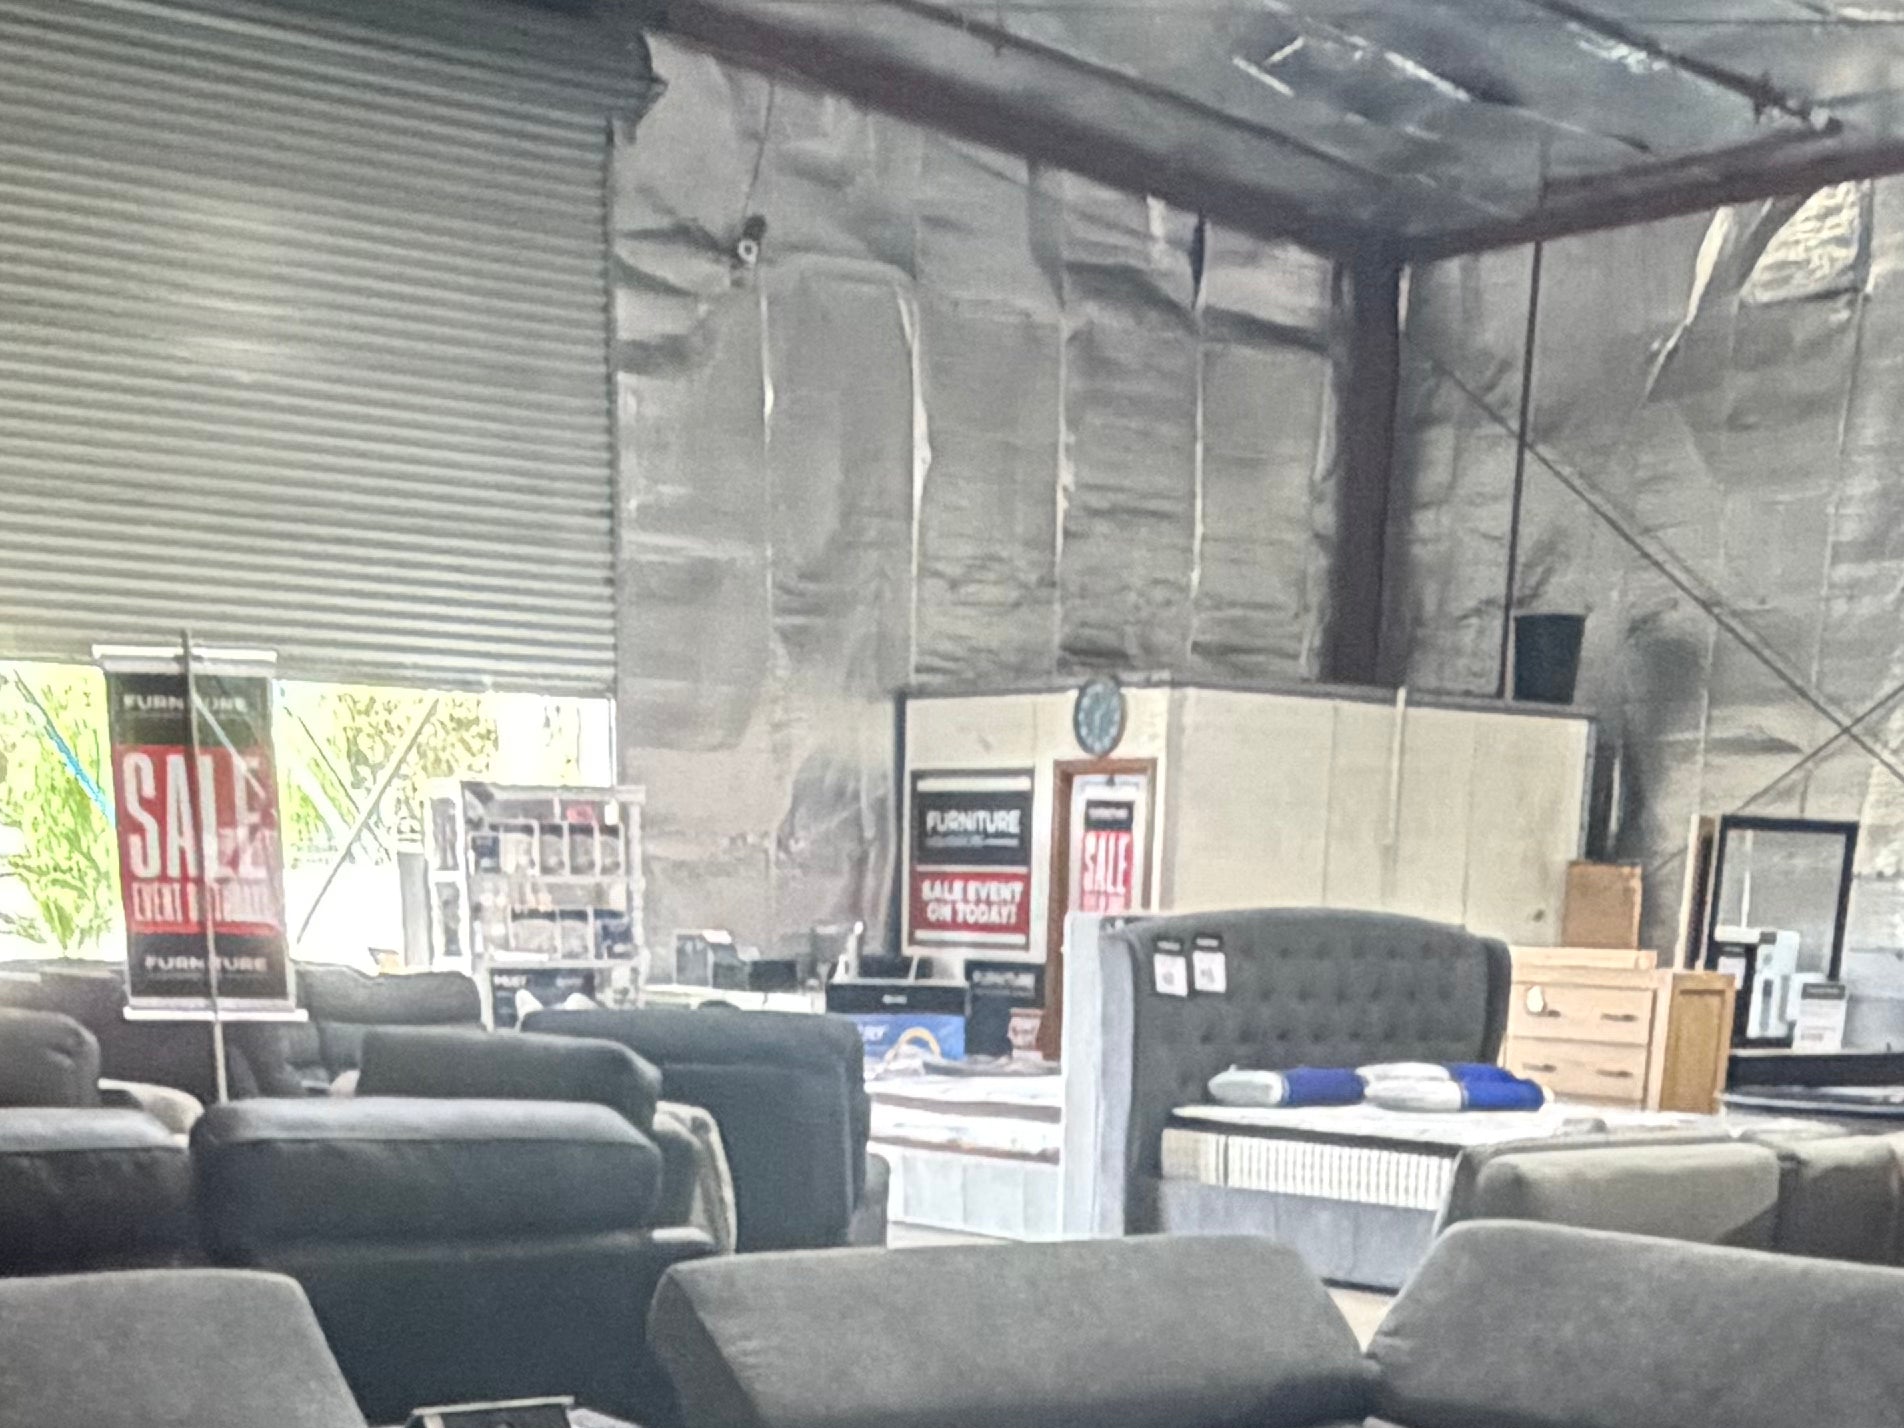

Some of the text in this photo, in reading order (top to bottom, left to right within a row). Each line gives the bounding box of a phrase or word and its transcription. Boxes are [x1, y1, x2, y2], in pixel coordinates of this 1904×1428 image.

[123, 751, 269, 879] SALE
[926, 808, 1022, 834] FURNITURE
[1083, 830, 1130, 895] SALE
[922, 879, 1024, 903] SALE EVENT
[926, 902, 952, 922] ON
